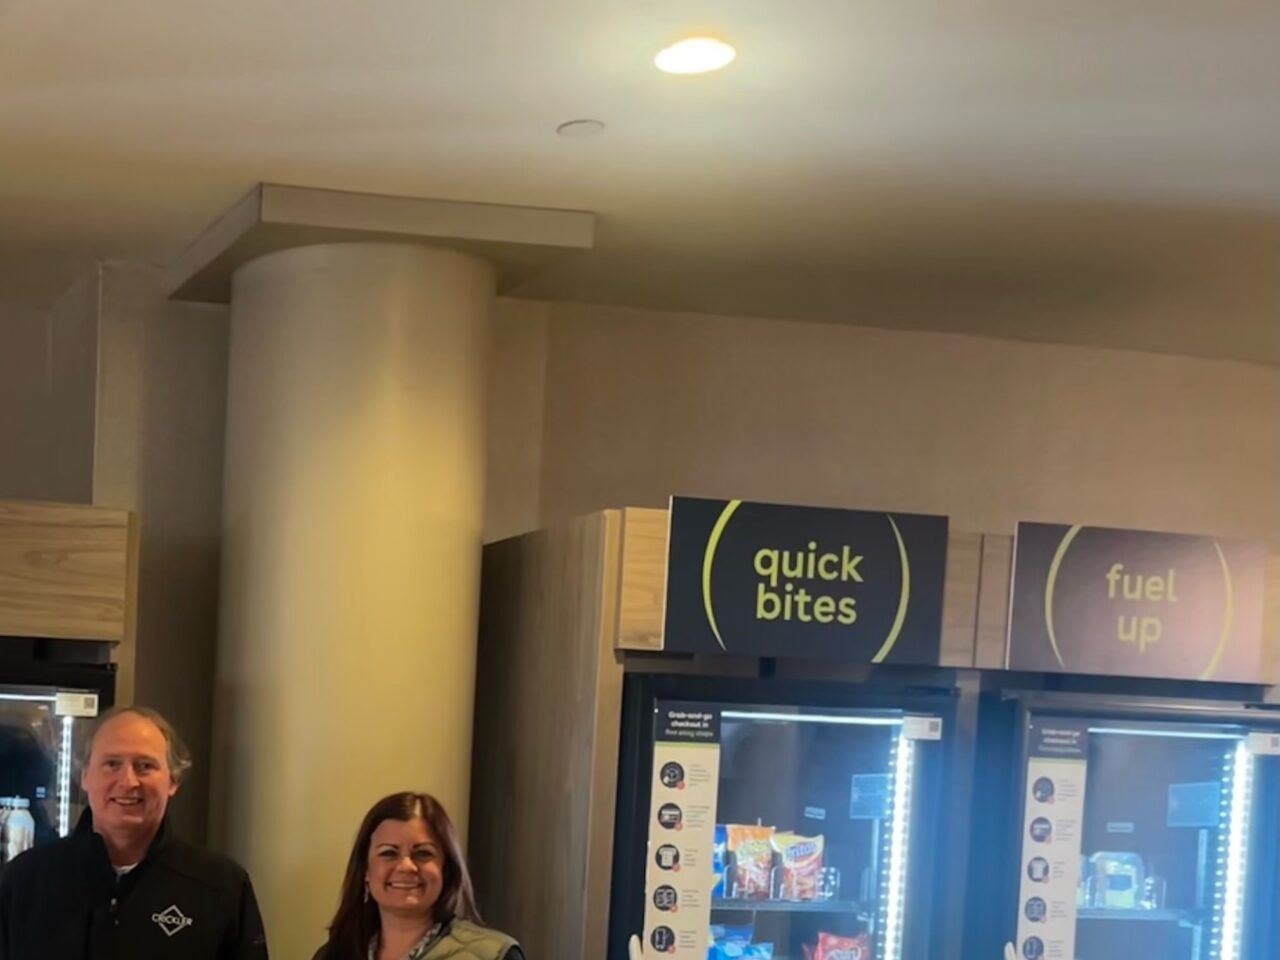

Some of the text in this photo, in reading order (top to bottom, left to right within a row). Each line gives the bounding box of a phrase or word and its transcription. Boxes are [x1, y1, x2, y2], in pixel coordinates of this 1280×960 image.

[753, 541, 864, 587] quick
[1105, 563, 1178, 603] fuel
[756, 582, 857, 625] bites
[1117, 614, 1163, 655] up
